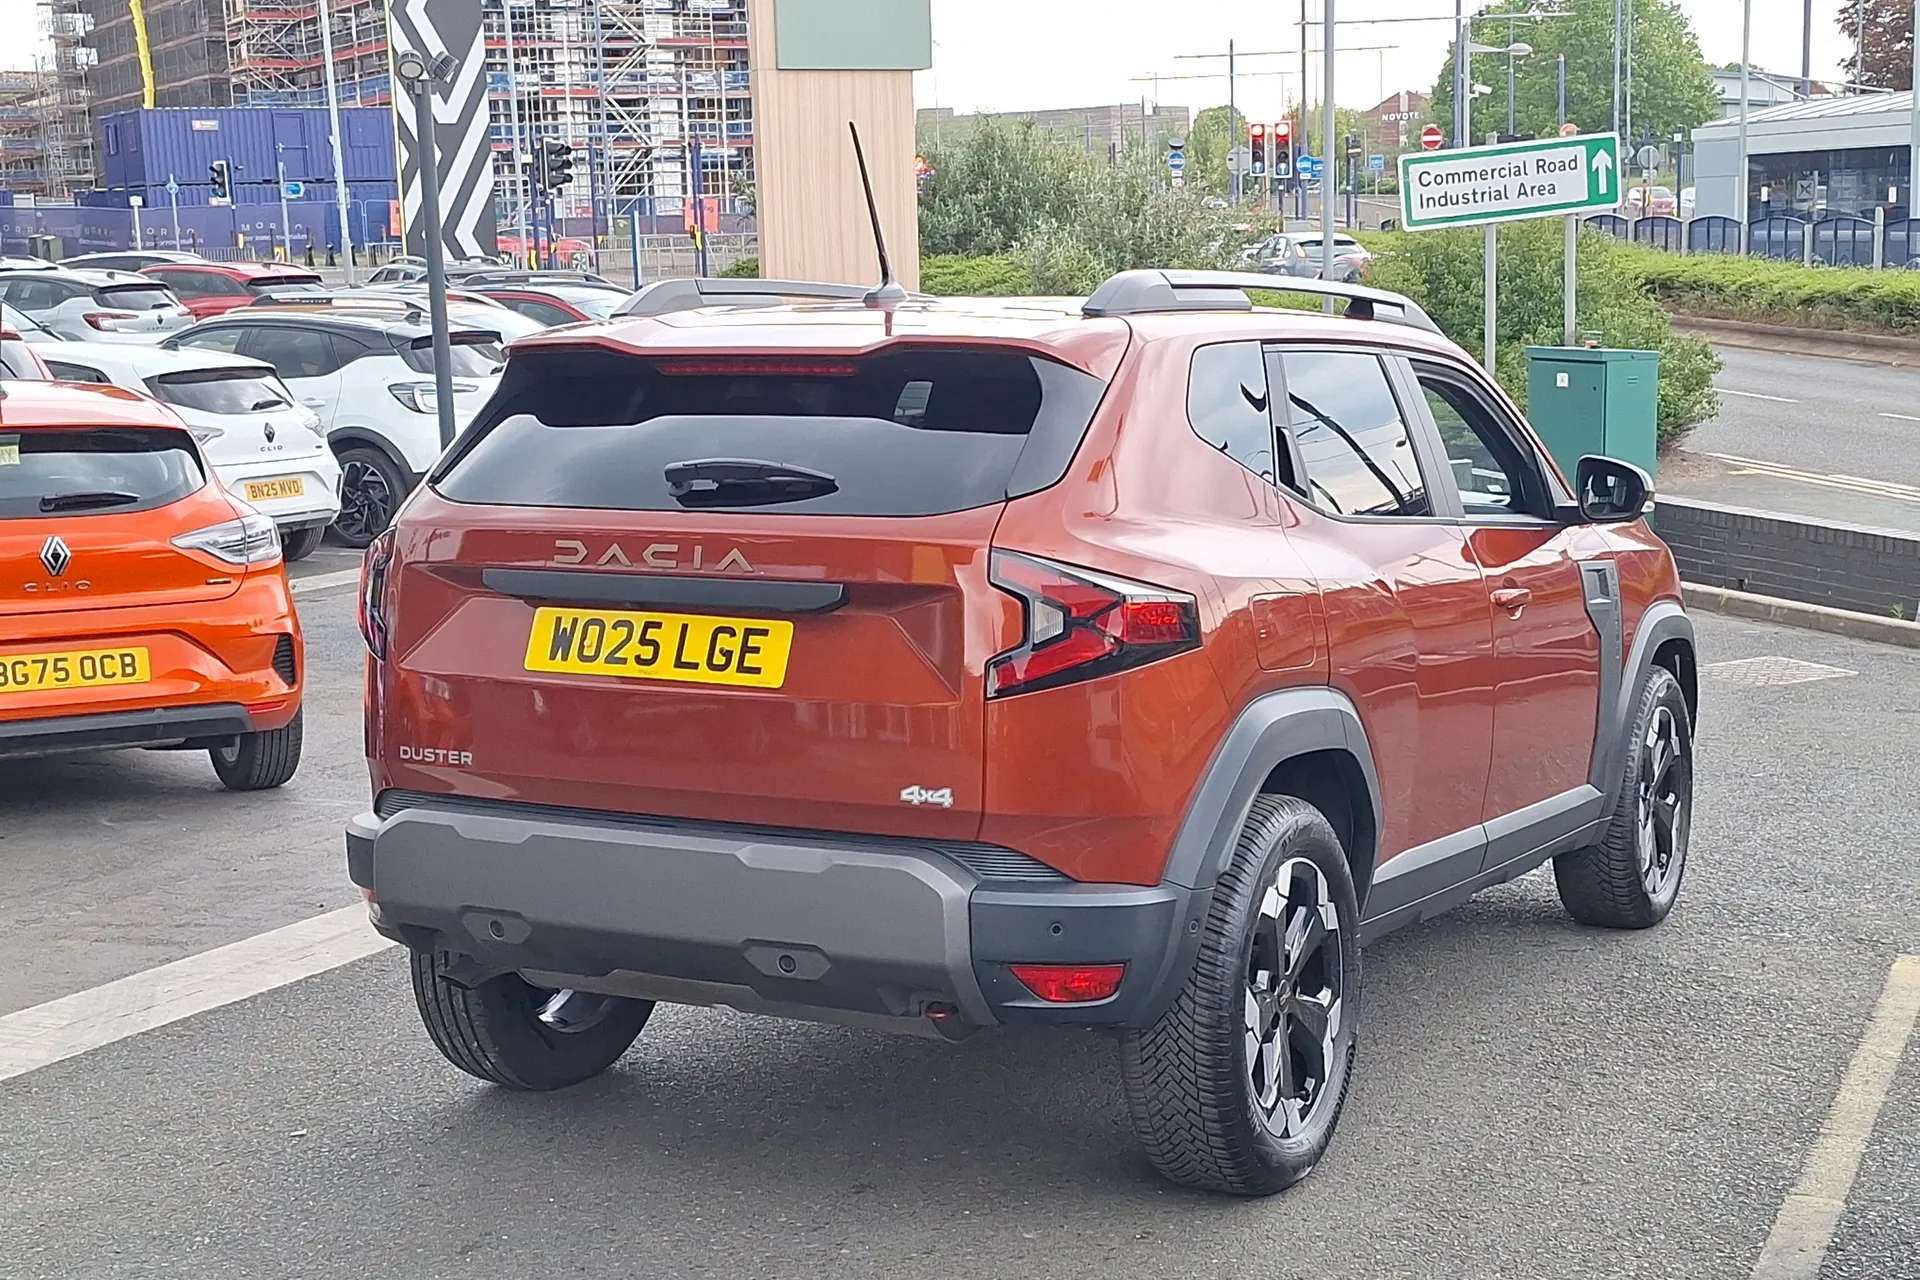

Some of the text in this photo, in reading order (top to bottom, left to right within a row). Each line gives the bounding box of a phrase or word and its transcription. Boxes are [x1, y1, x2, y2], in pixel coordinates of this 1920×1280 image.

[1418, 154, 1578, 187] Commercial Road
[1420, 182, 1557, 209] Industrial Area
[250, 482, 278, 499] BN25
[553, 539, 754, 573] DACIA
[24, 580, 91, 592] CLIO
[549, 616, 769, 675] WO25 LGE
[80, 653, 137, 680] OCB
[400, 746, 472, 765] DUSTER
[900, 784, 953, 808] 4x4
